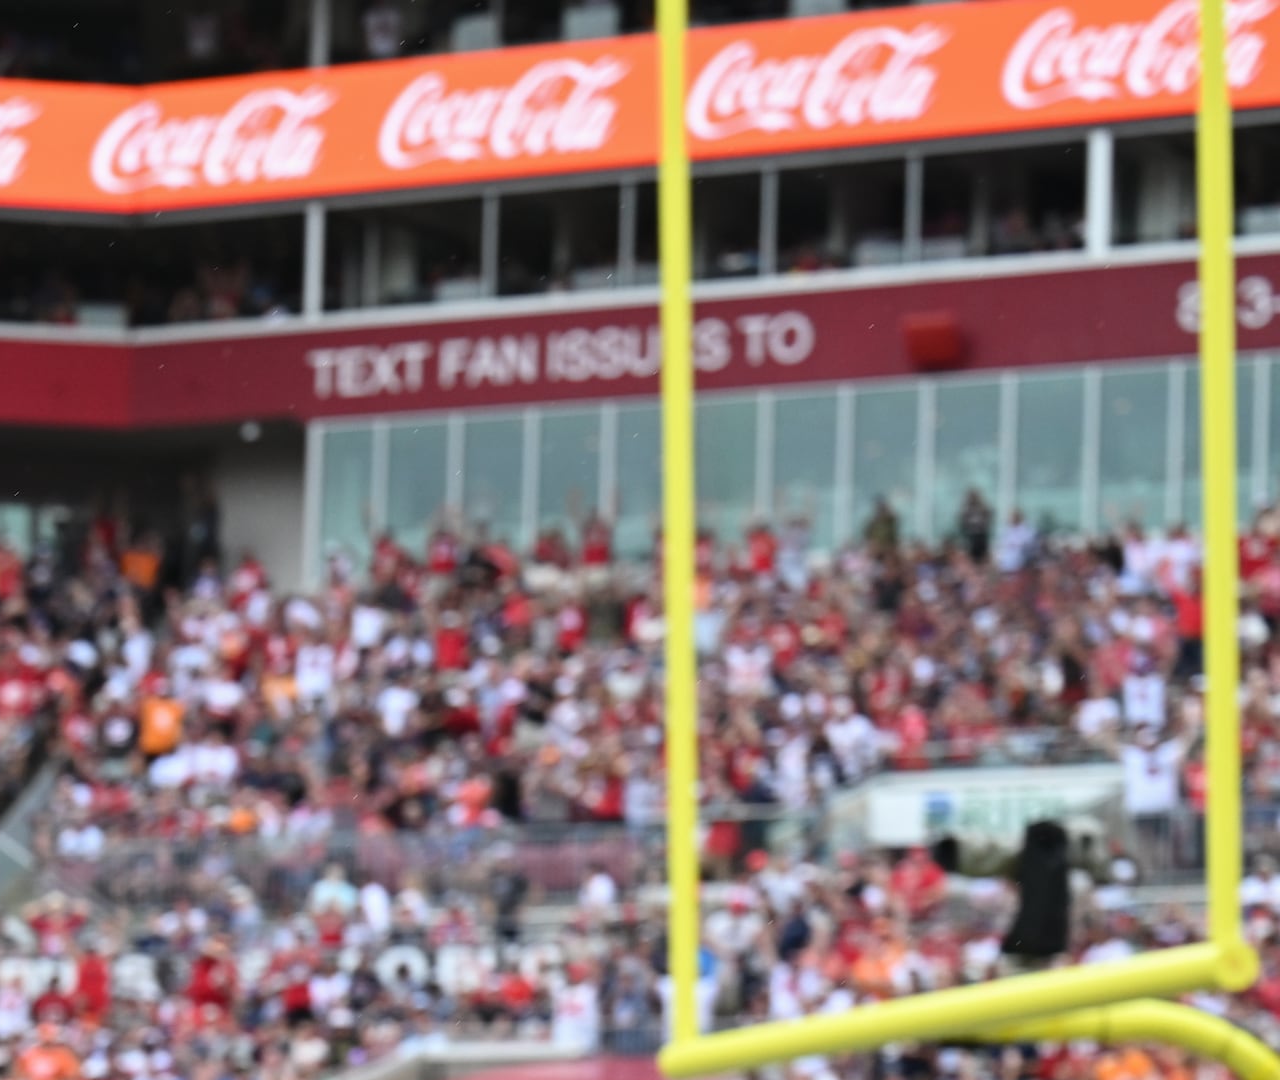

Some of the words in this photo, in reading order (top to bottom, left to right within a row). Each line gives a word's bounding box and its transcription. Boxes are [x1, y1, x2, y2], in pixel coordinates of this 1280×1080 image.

[1001, 0, 1279, 110] Coca-Coa
[304, 341, 432, 398] TEXT
[438, 334, 539, 390] FAN
[544, 316, 733, 383] ISSUS
[736, 309, 816, 368] TO
